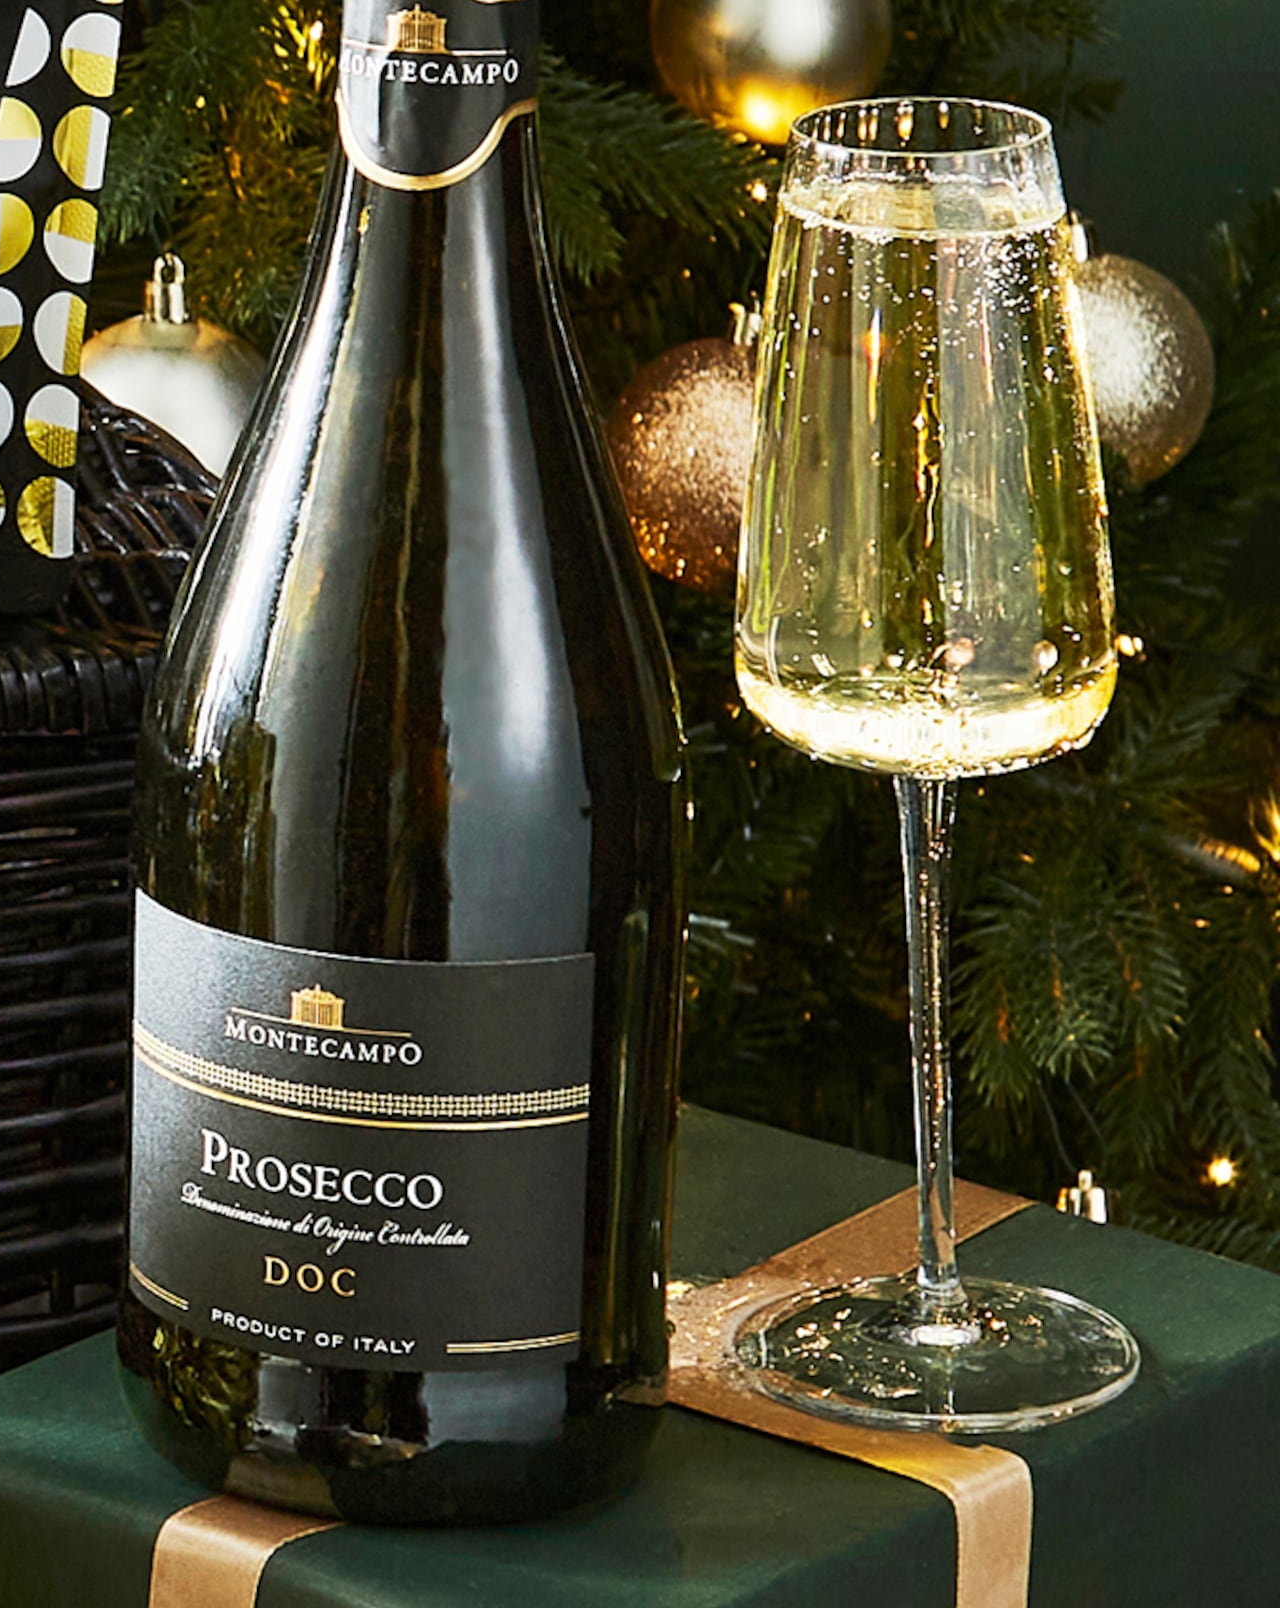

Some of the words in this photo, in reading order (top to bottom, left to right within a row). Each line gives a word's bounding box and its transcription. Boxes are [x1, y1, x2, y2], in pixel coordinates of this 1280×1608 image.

[224, 1013, 424, 1066] MONTECAMPO
[199, 1127, 445, 1211] PROSECCO
[292, 1213, 314, 1234] di
[313, 1215, 376, 1257] Origine
[377, 1220, 471, 1247] Controllata
[262, 1254, 358, 1299] DOC
[210, 1307, 307, 1343] PRODUCT
[315, 1332, 345, 1349] OF
[353, 1337, 417, 1355] ITALY
